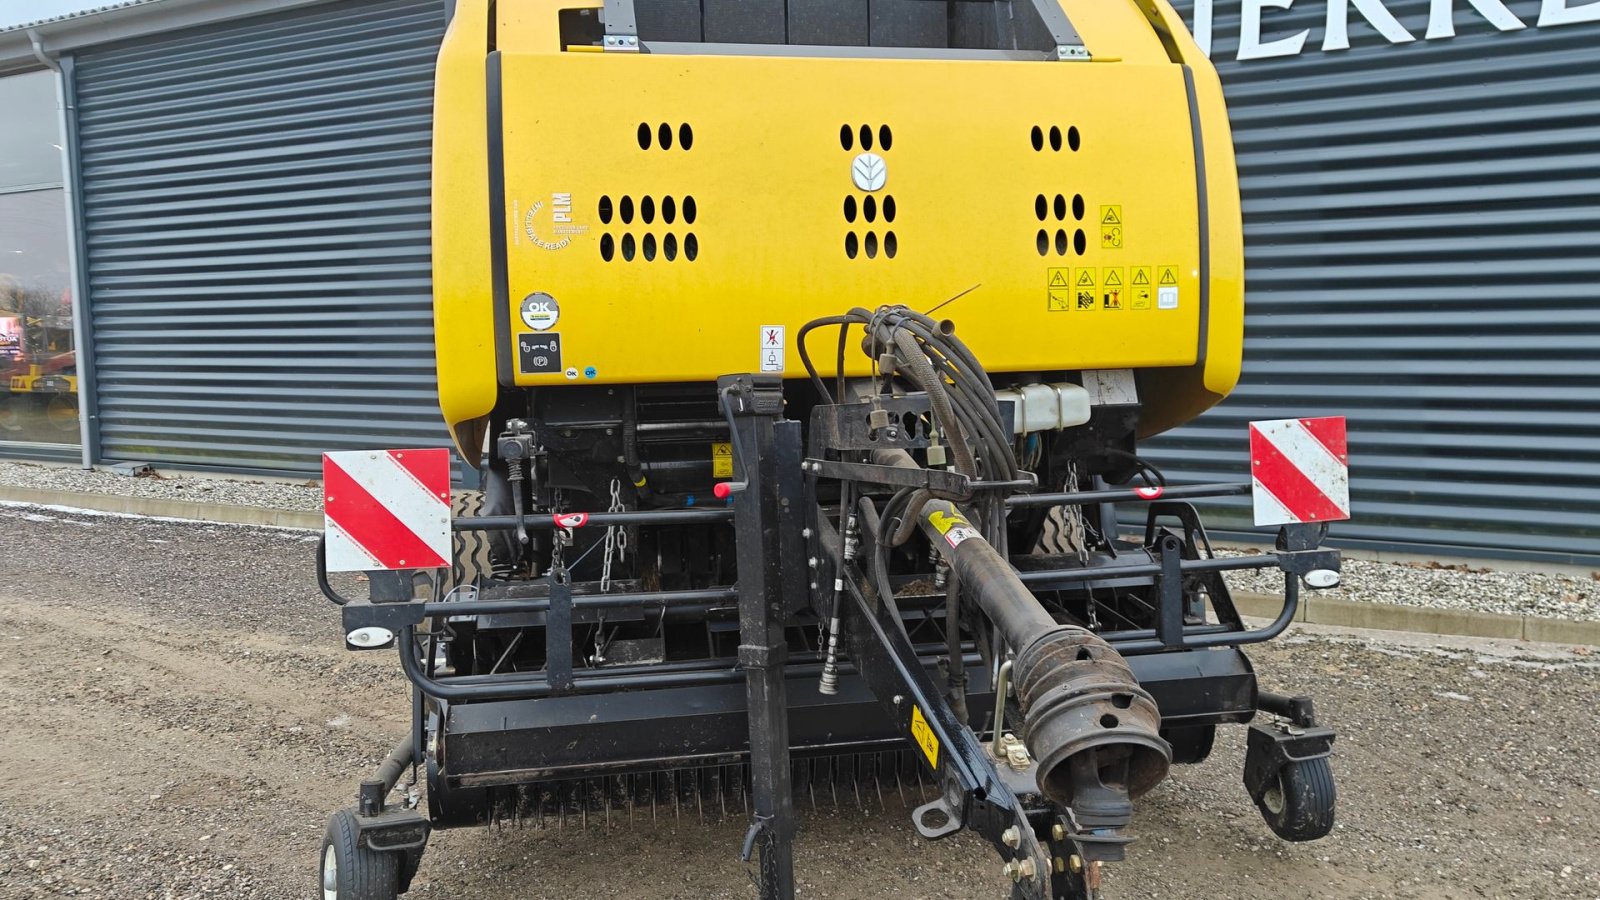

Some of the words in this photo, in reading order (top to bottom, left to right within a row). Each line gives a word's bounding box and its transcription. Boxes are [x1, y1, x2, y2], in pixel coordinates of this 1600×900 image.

[552, 193, 571, 223] PLM
[545, 235, 571, 250] READY
[529, 302, 550, 312] OK
